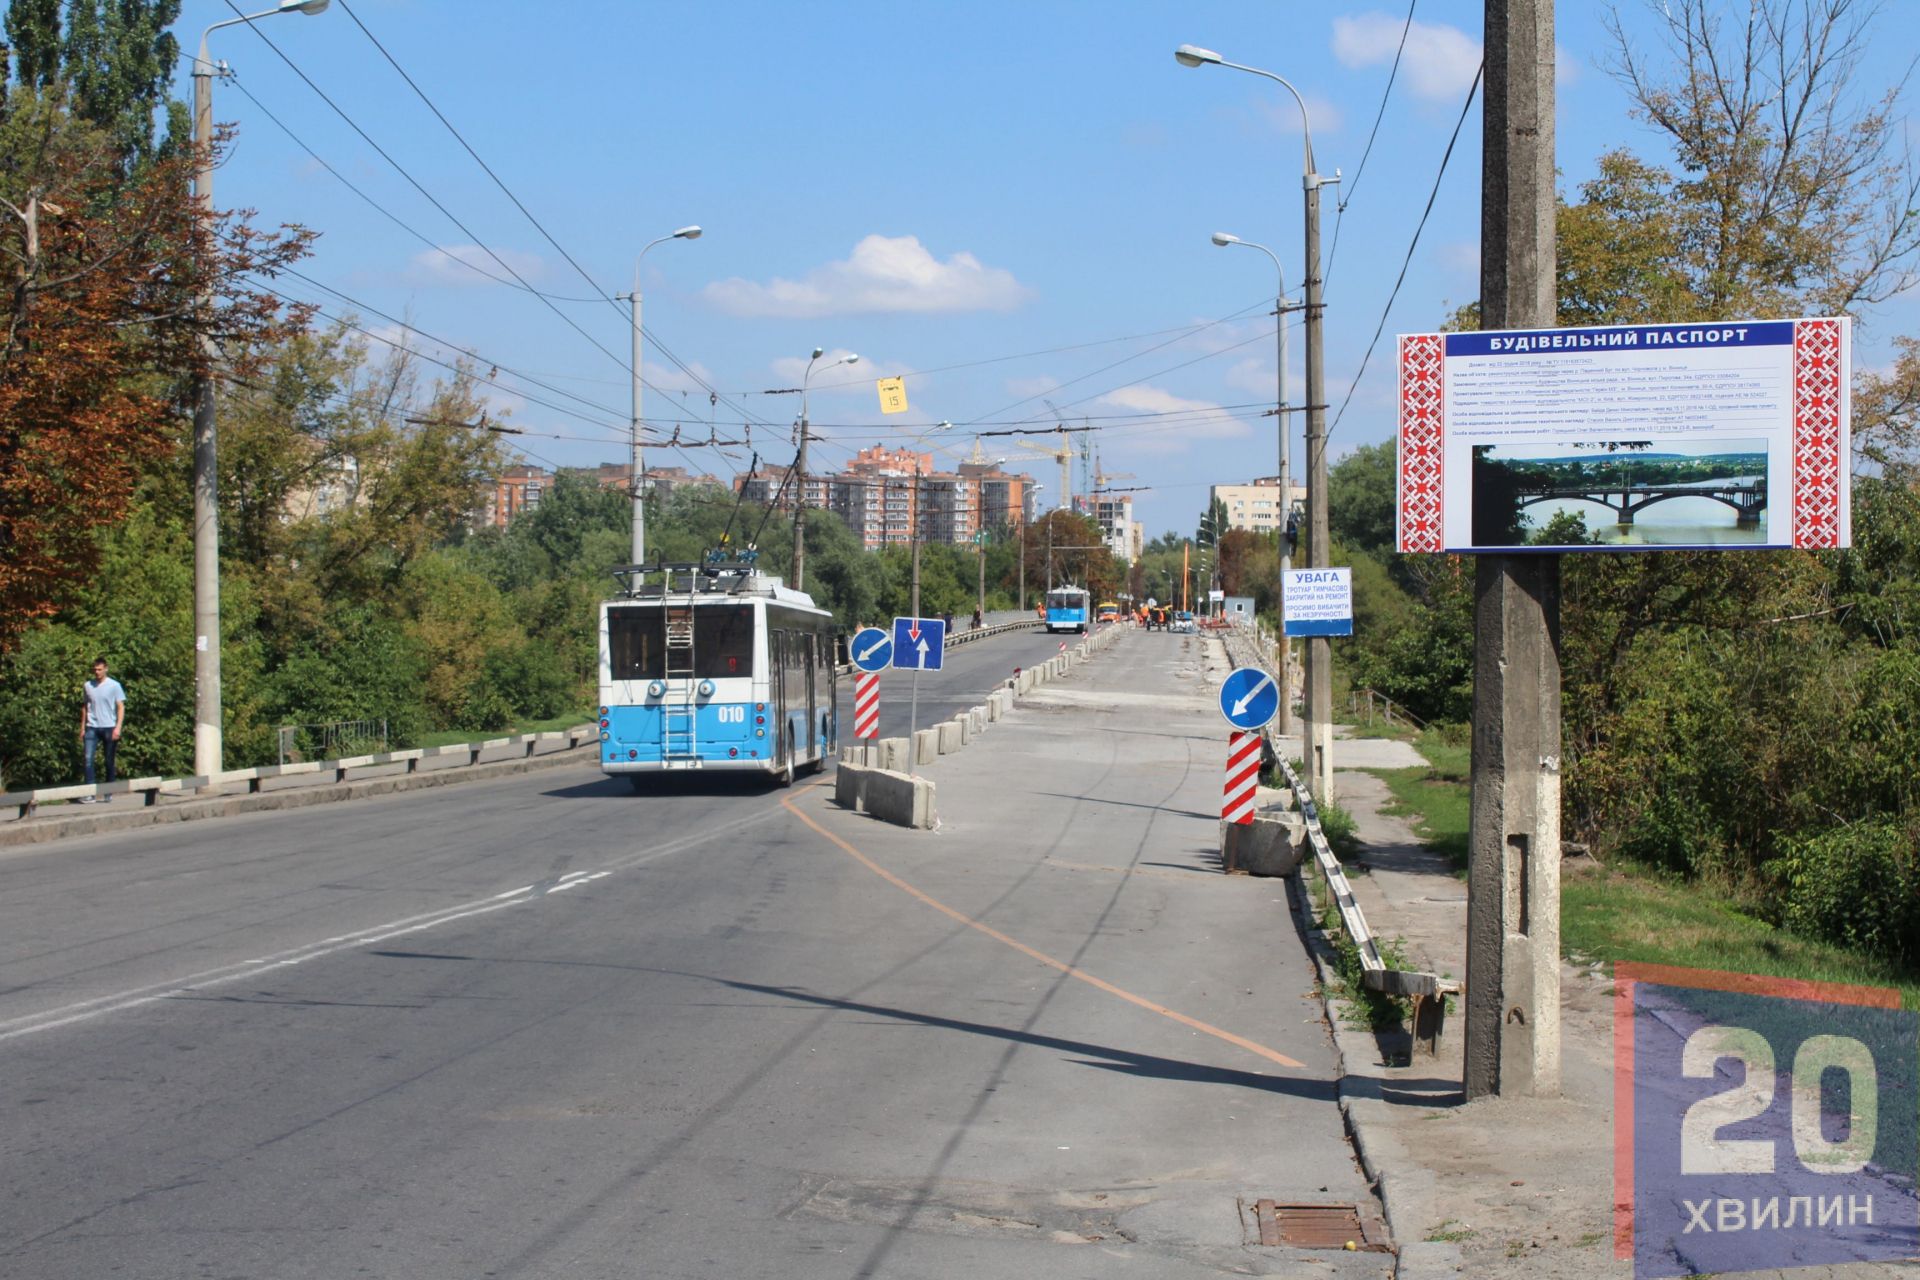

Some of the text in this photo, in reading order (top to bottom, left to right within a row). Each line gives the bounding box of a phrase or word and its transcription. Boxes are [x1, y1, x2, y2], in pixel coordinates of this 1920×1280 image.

[1490, 328, 1749, 351] БУДІВЕЛЬНИЙ ПАСПОРТ
[1296, 572, 1340, 583] УВАГА
[1313, 585, 1348, 593] ТИМЧАСОВО
[1286, 603, 1349, 612] ПРОСИМО ВИБАЧИТИ
[718, 706, 744, 723] 010
